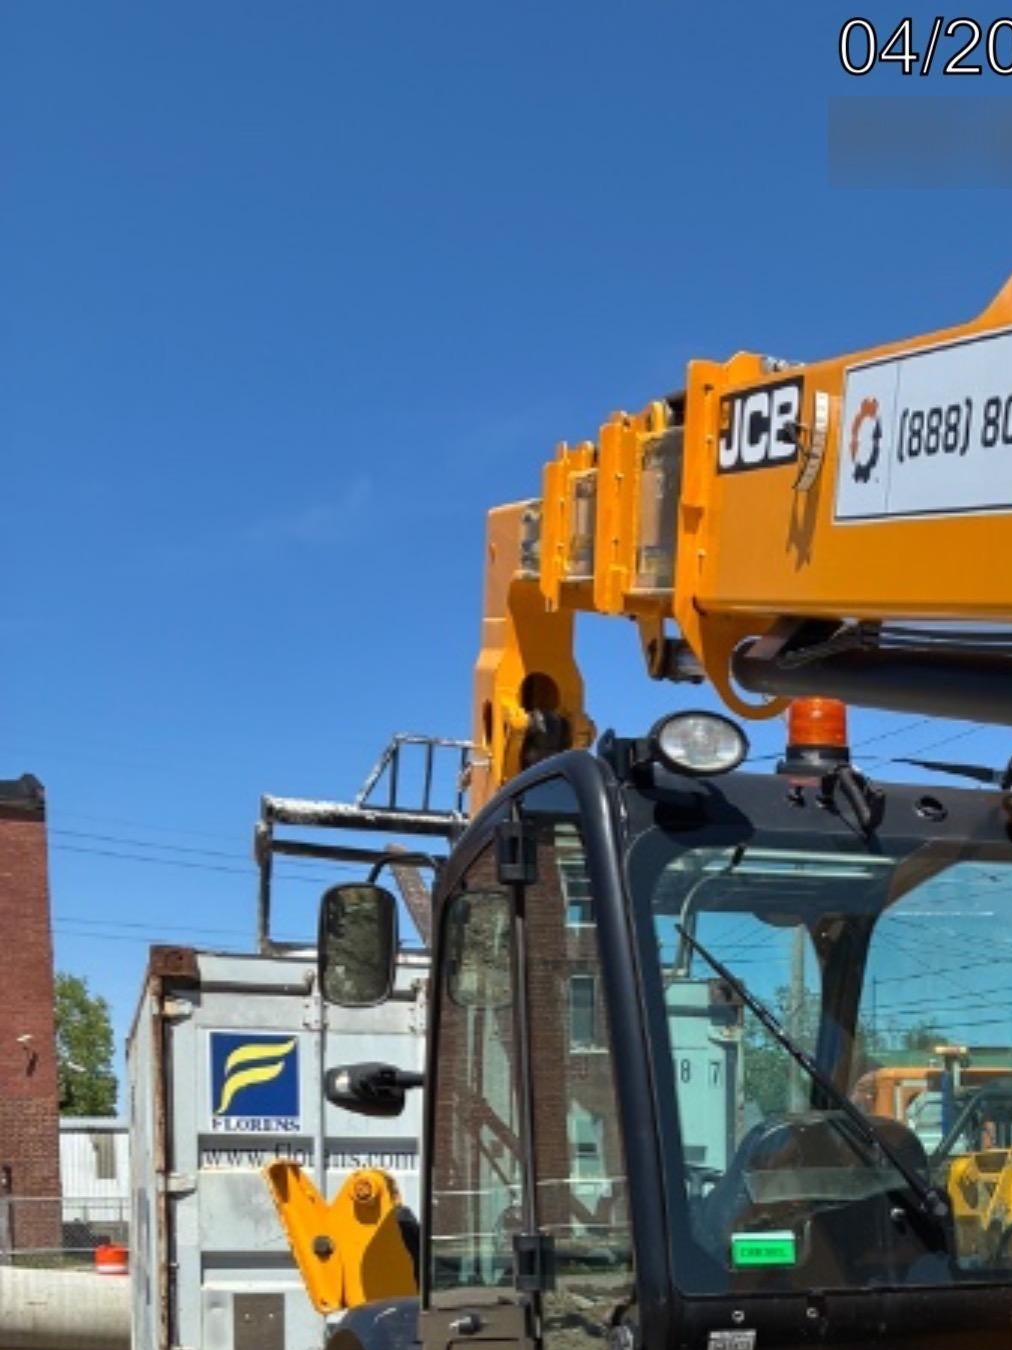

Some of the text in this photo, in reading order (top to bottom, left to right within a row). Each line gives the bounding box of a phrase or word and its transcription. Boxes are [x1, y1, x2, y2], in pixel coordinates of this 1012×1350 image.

[719, 386, 799, 469] JCB
[897, 397, 973, 464] (888)
[212, 1117, 300, 1133] FLORENS
